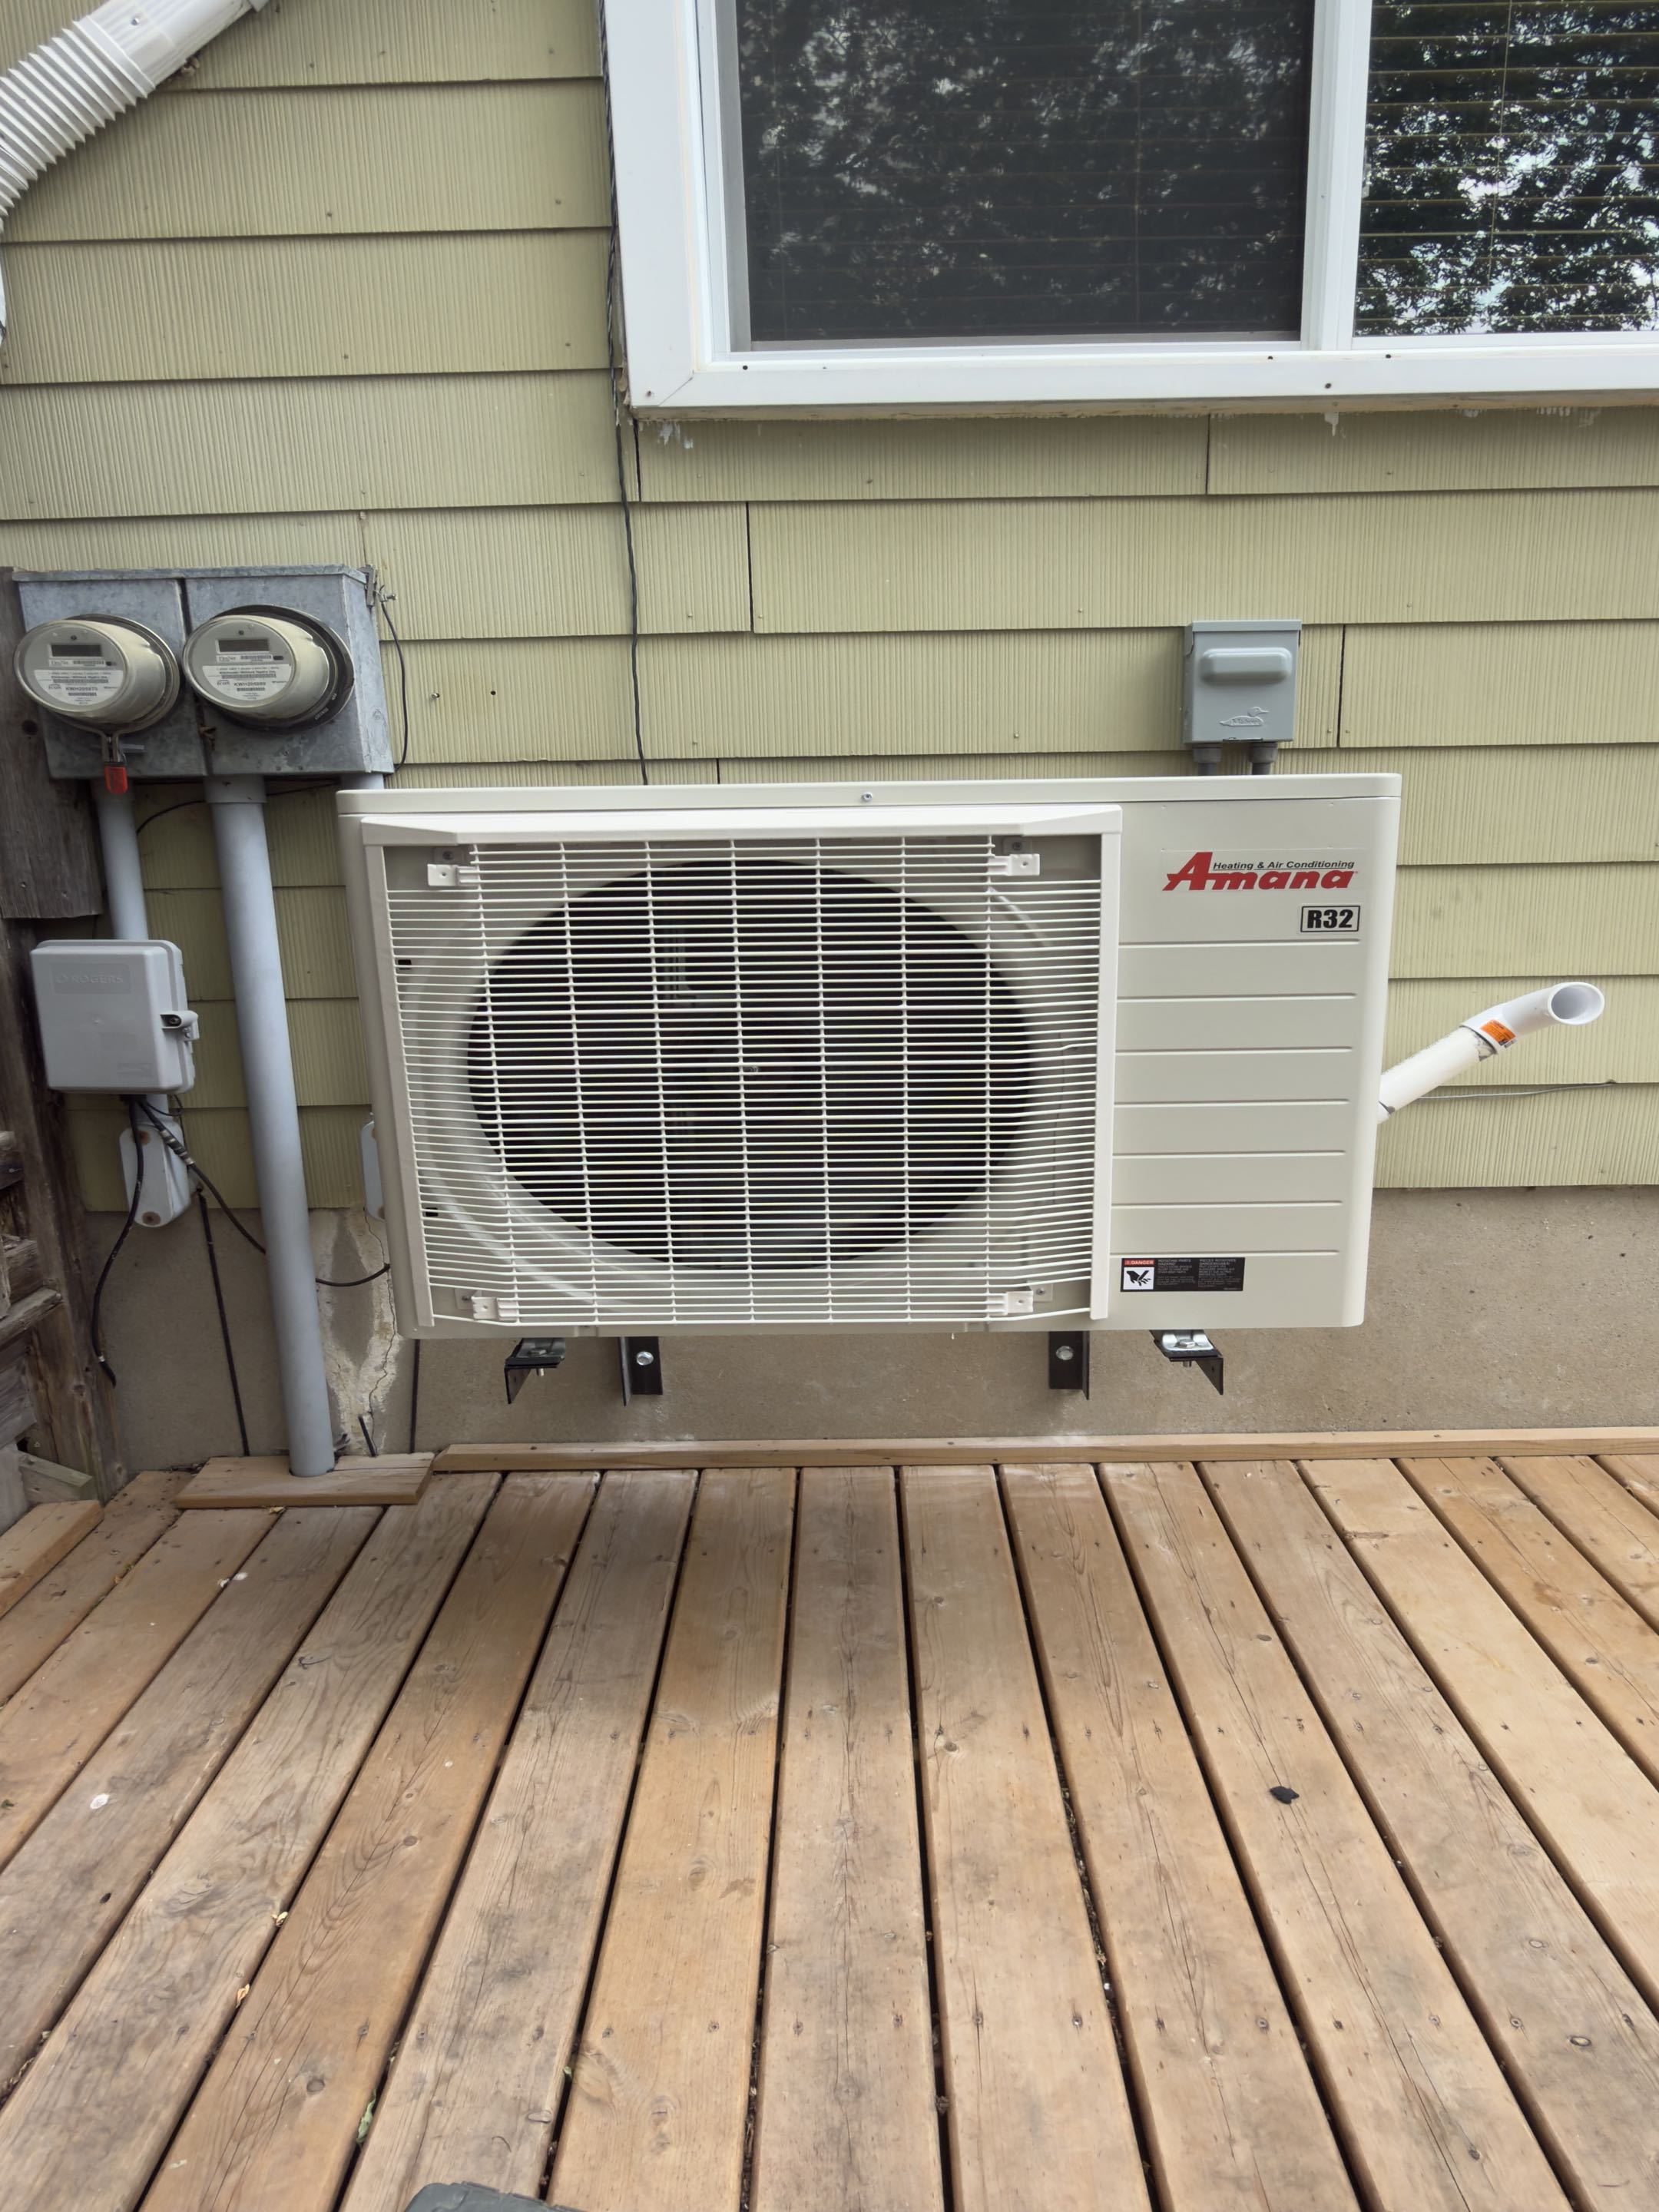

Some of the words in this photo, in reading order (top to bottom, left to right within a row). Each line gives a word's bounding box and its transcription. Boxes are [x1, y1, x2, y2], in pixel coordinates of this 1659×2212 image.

[1162, 852, 1356, 891] Amana
[1213, 862, 1253, 870] Heating
[1286, 860, 1355, 869] Conditioning
[1306, 909, 1353, 929] R32
